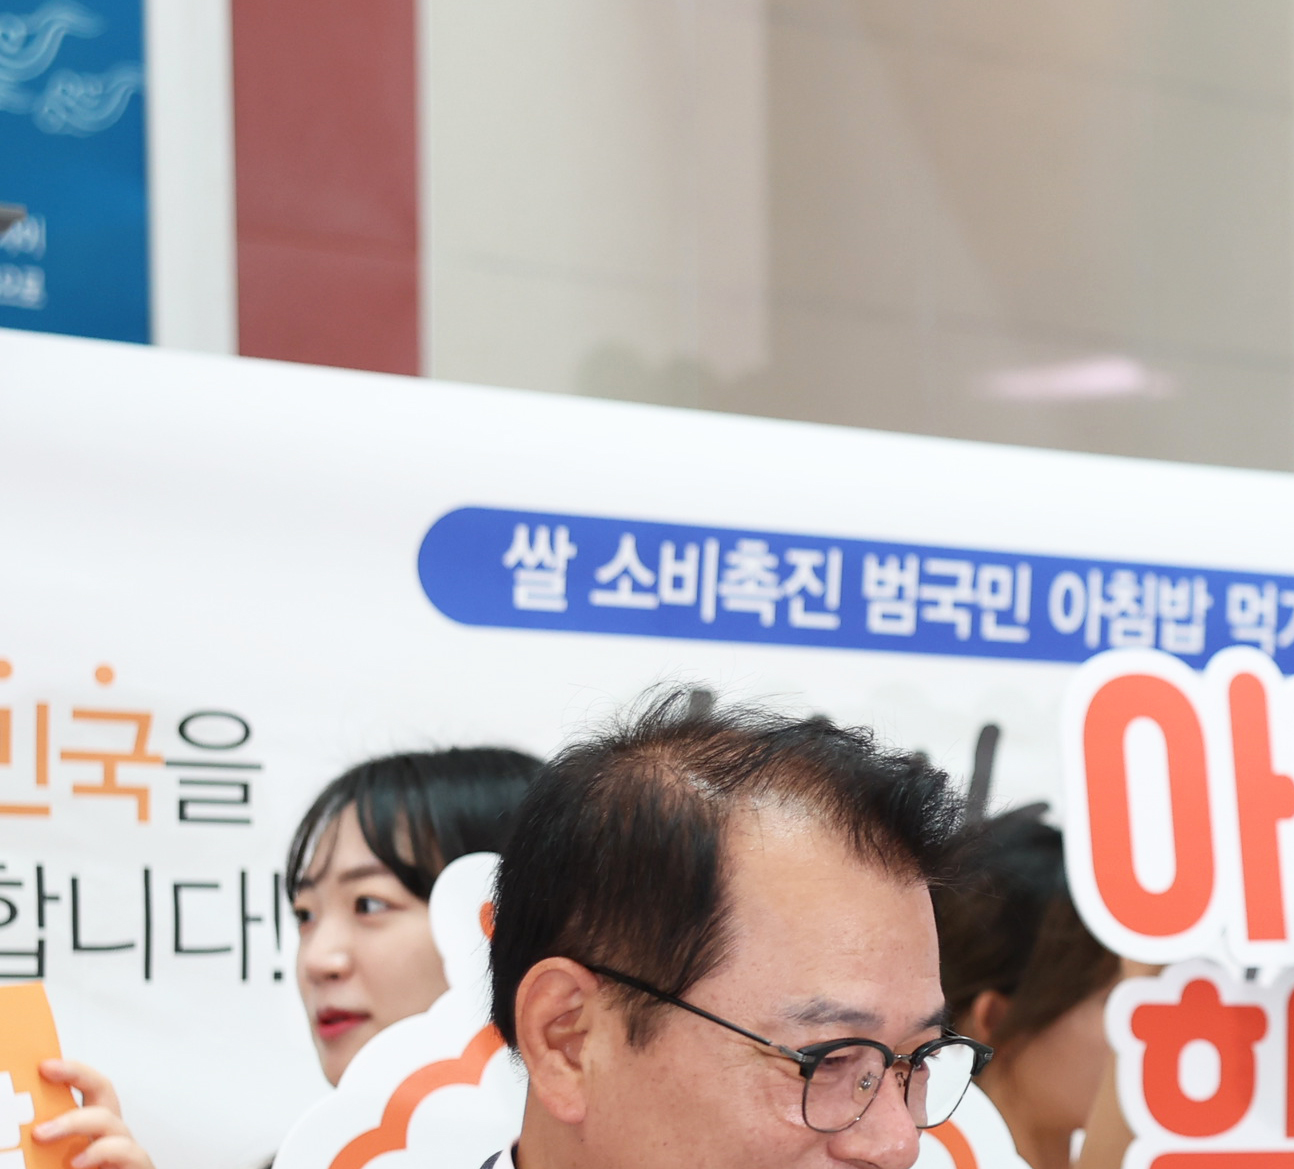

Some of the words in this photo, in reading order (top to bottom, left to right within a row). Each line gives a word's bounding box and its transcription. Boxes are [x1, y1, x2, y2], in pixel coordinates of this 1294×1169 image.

[503, 524, 577, 612] 쌀
[589, 533, 843, 629] 소비촉진
[861, 551, 1032, 643] 범국민
[1047, 563, 1213, 657] 아침밥
